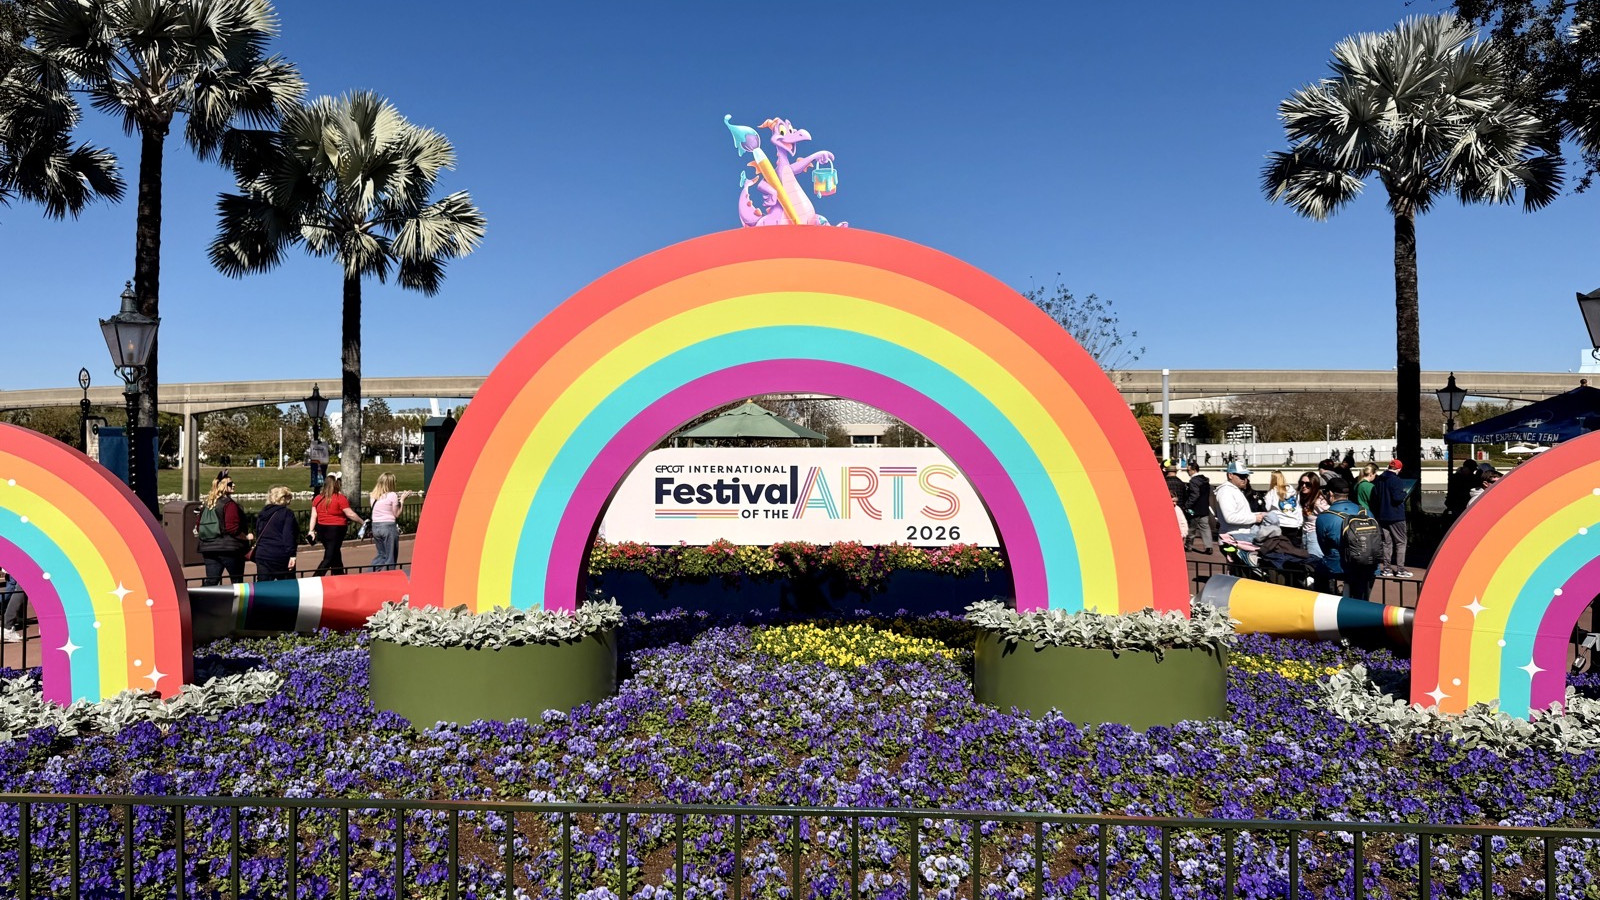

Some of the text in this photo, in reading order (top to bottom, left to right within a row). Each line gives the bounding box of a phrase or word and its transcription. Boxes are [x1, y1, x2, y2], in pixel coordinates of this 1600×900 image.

[1473, 434, 1494, 443] GUEST
[1538, 432, 1559, 442] TEAM
[655, 465, 787, 473] EPCOT INTERNATIONAL
[655, 465, 798, 504] Festival
[792, 464, 960, 520] ARTS
[741, 509, 788, 518] OF THE
[906, 526, 960, 540] 2026
